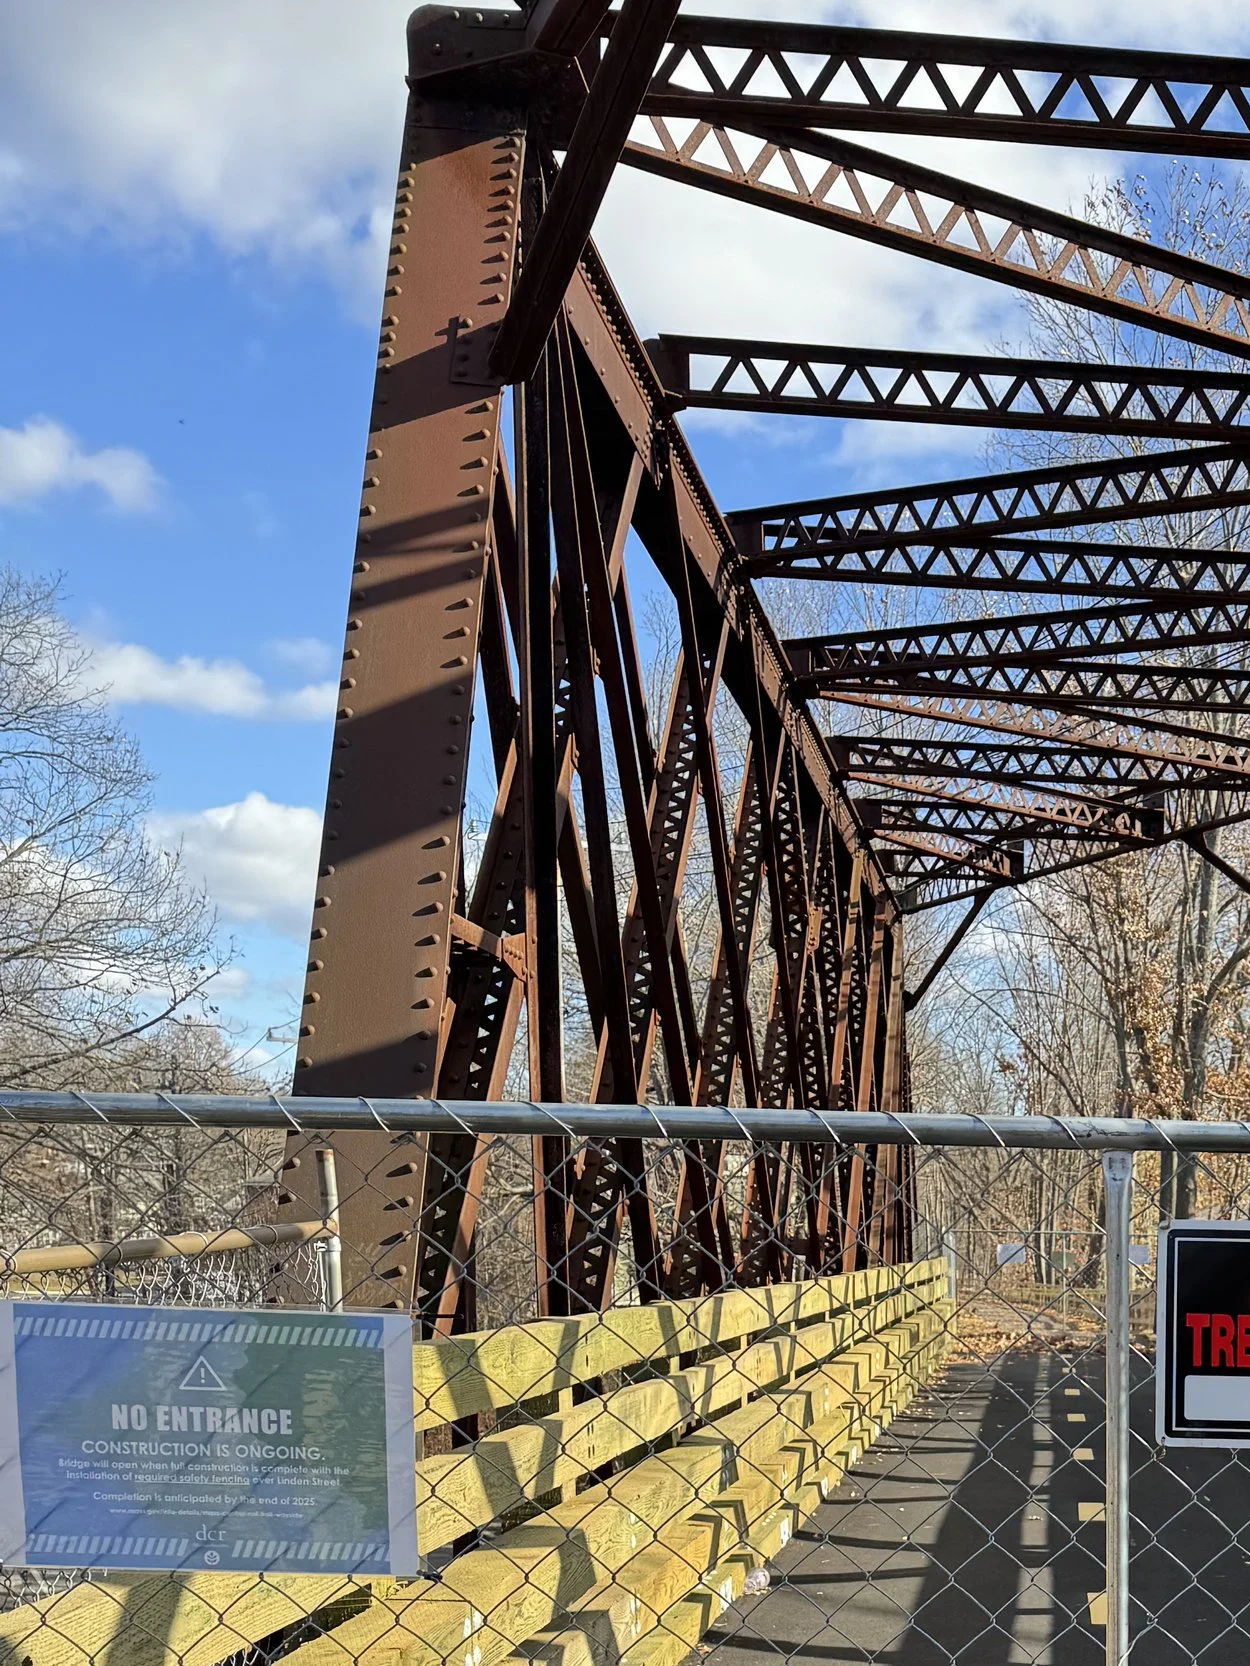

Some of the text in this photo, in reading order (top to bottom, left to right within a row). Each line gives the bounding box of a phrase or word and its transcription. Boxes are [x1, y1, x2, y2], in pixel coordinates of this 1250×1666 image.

[111, 1403, 293, 1435] NO ENTRANCE
[81, 1440, 326, 1461] CONSTRUCTION IS ONGOING.
[58, 1458, 350, 1476] Bridge will open when full construction is complete with the
[66, 1470, 120, 1480] installation
[122, 1471, 132, 1480] of
[134, 1473, 177, 1483] required
[179, 1474, 208, 1484] safety
[211, 1475, 250, 1485] fencing
[277, 1476, 309, 1486] Linden
[93, 1491, 151, 1503] Completion
[154, 1492, 162, 1501] is
[164, 1493, 222, 1505] anticipated
[224, 1494, 238, 1505] by
[258, 1496, 277, 1505] end
[280, 1497, 290, 1506] of
[292, 1497, 318, 1506] 2025.
[195, 1524, 227, 1541] dcr
